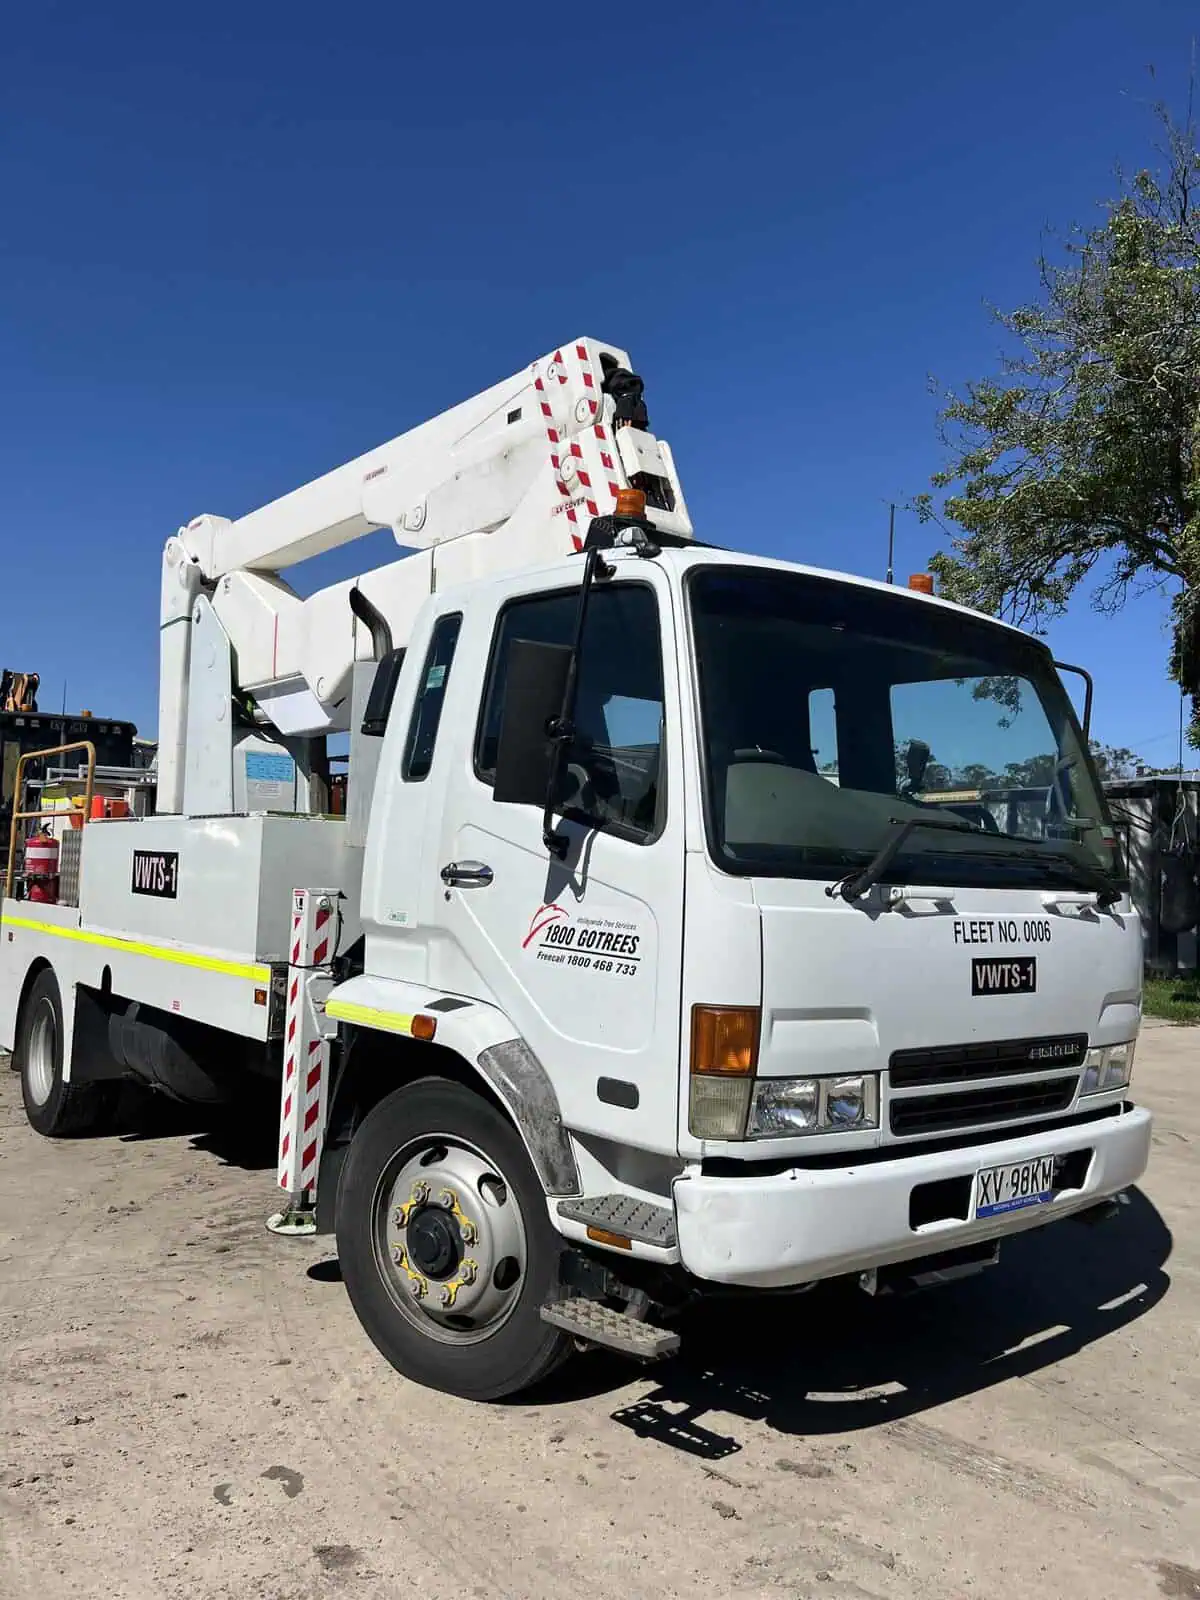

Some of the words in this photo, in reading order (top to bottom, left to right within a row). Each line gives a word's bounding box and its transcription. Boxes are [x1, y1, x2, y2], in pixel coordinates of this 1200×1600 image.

[135, 855, 177, 893] VWTS-1
[544, 924, 576, 946] 1800
[577, 929, 640, 954] GOTREES
[953, 920, 995, 944] FLEET
[999, 920, 1021, 943] NO.
[1023, 920, 1052, 943] 0006
[536, 951, 565, 964] Freecall
[567, 954, 591, 969] 1800
[592, 959, 614, 973] 468
[615, 963, 638, 977] 733
[975, 962, 1035, 989] VWTS-1
